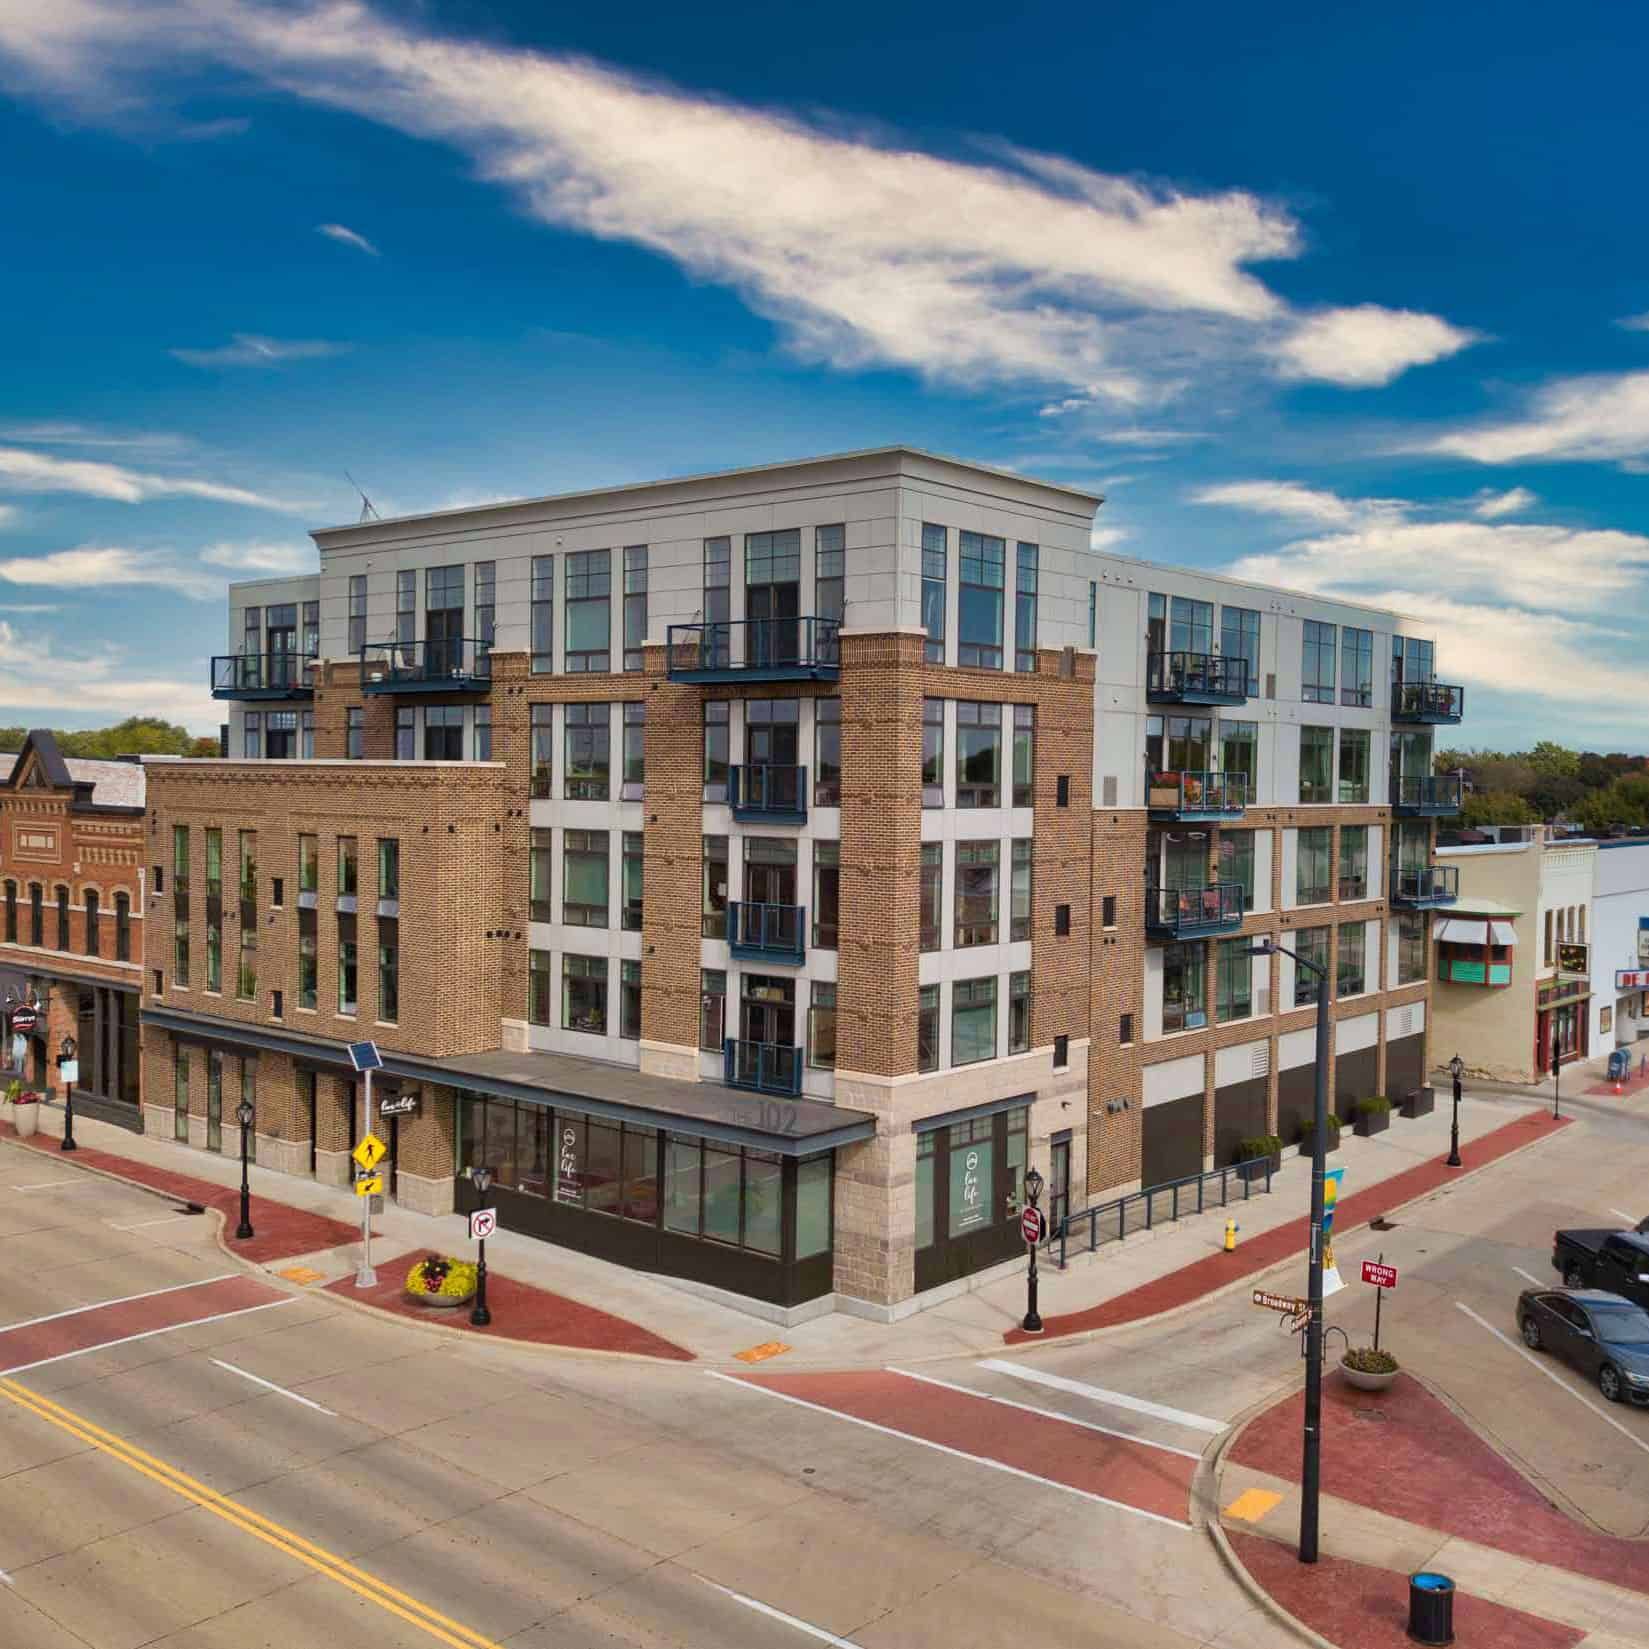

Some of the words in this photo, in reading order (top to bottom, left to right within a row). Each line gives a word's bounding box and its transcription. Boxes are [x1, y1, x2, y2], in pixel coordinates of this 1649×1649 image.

[1365, 1264, 1395, 1278] WRONG
[1370, 1274, 1388, 1285] WAY
[1262, 1295, 1296, 1313] Broadway
